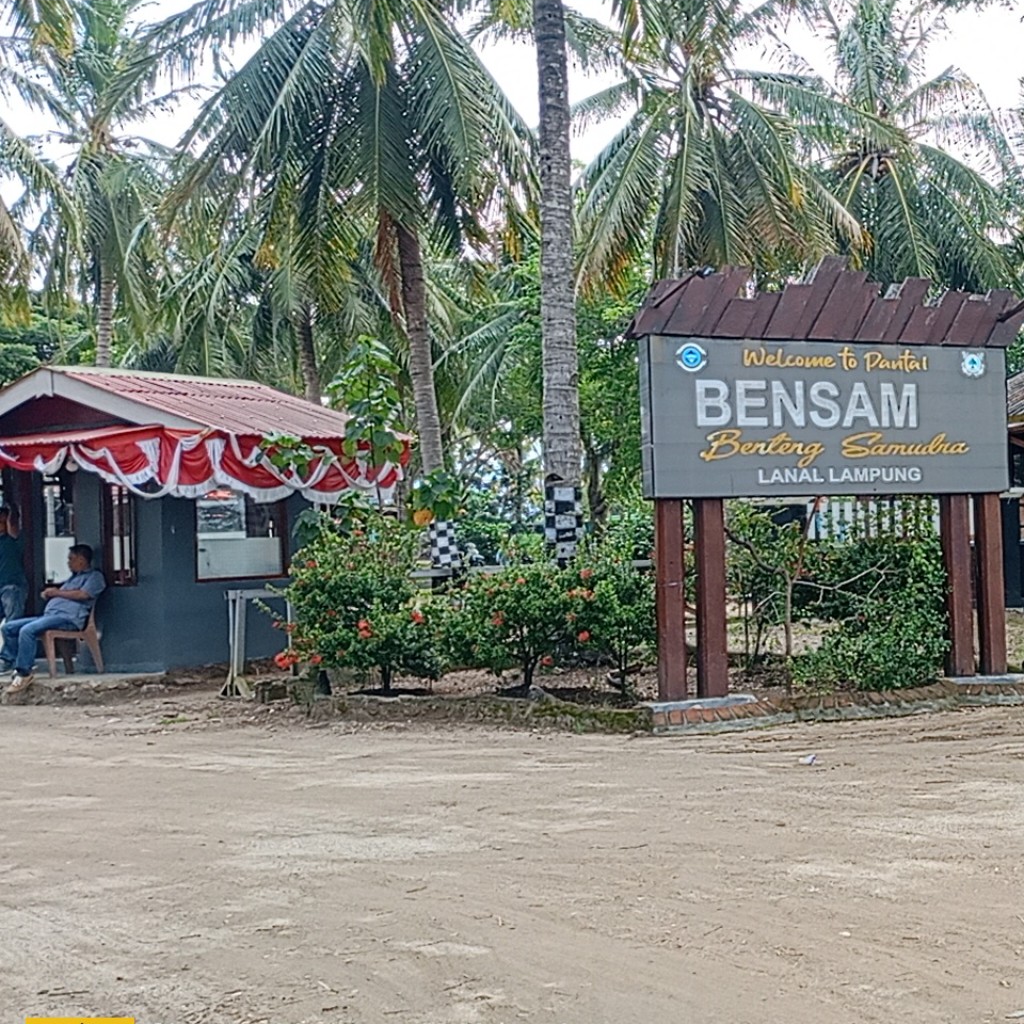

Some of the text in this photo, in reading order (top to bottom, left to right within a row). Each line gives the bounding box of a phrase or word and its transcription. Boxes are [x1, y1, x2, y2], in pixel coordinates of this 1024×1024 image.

[743, 347, 928, 373] Welcome to Pantai
[695, 379, 918, 429] BENSAM
[700, 429, 970, 467] Benteng Samudra
[758, 467, 922, 484] LANAL LAMPUNG
